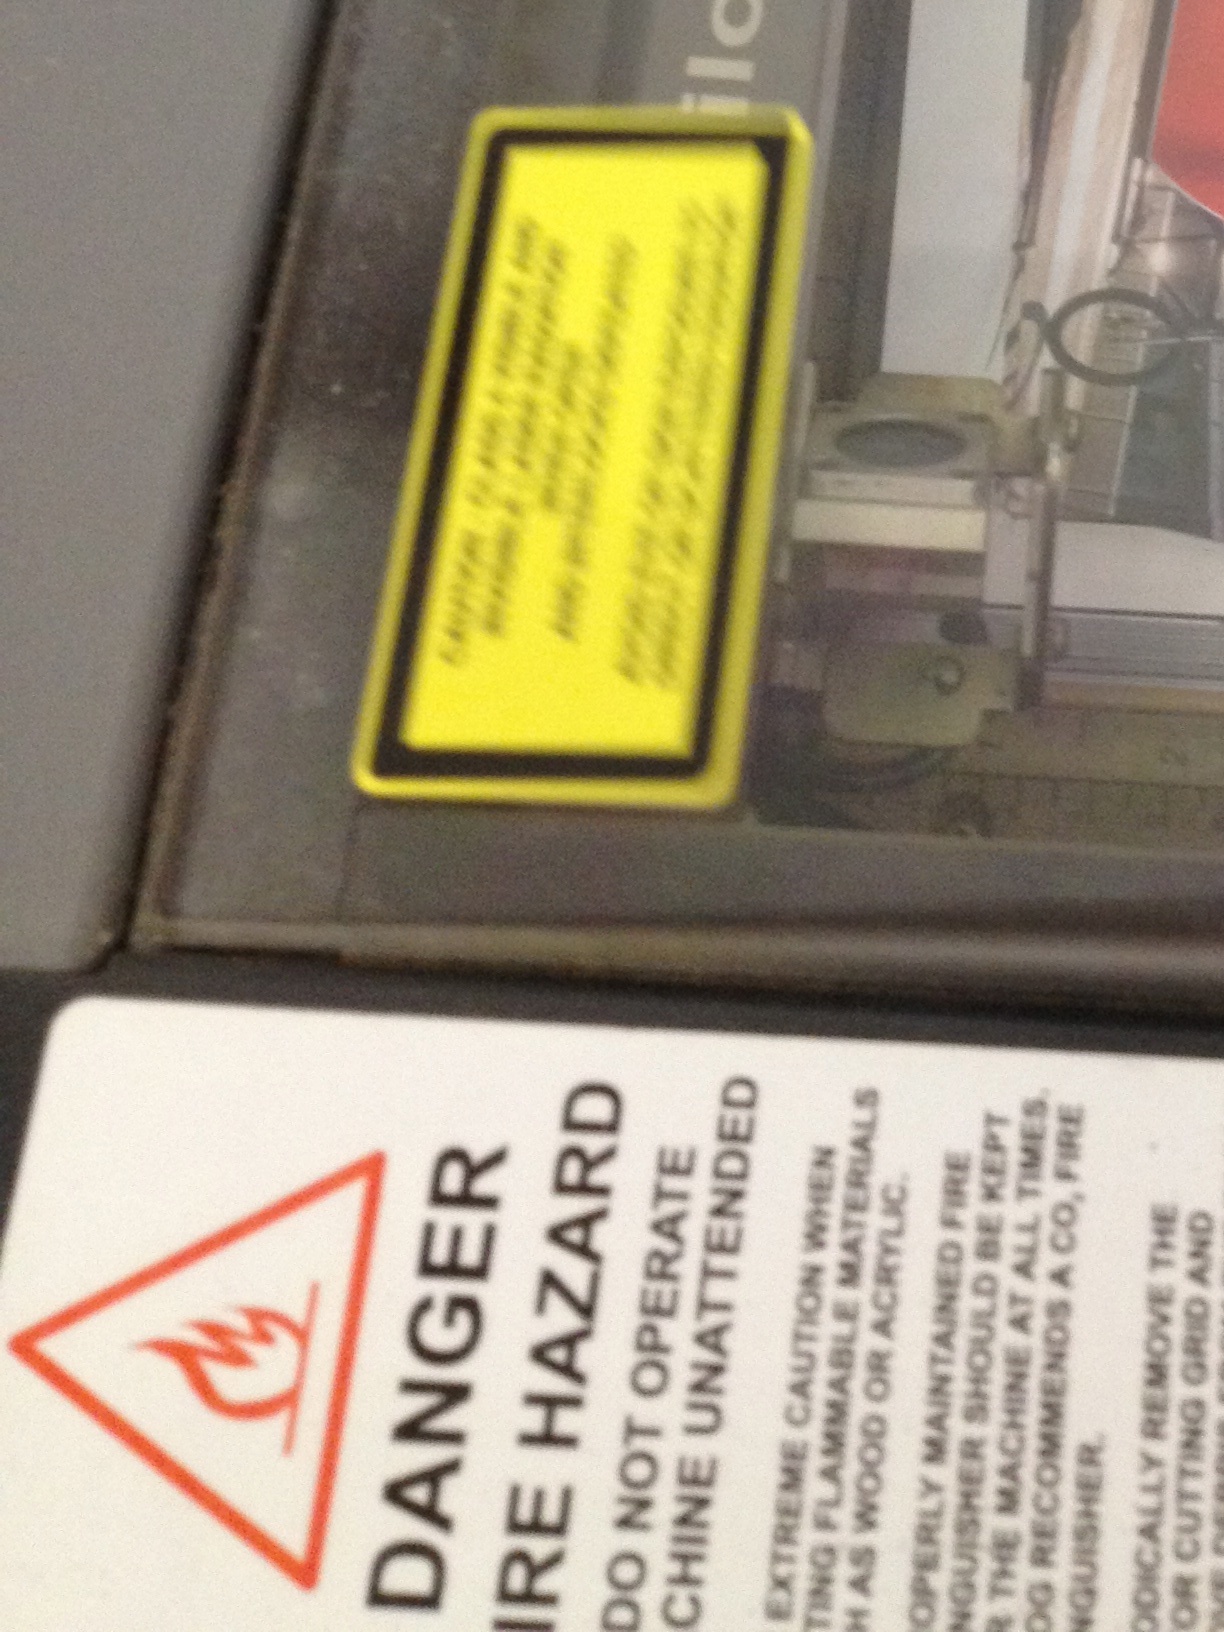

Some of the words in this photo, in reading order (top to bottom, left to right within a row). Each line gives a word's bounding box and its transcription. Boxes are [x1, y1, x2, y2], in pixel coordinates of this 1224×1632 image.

[803, 1145, 837, 1253] WHEN
[836, 1088, 879, 1289] MATERIALS
[939, 1152, 971, 1231] FIRE
[980, 1112, 1009, 1204] KEPT
[1053, 1105, 1084, 1183] FIRE
[518, 1081, 623, 1450] HAZARD
[629, 1147, 696, 1399] OPERATE
[683, 1075, 759, 1437] UNATTENDED
[974, 1214, 1003, 1263] BE
[1011, 1216, 1041, 1281] ALL
[1048, 1264, 1073, 1289] A
[1148, 1204, 1179, 1271] THE
[1186, 1210, 1215, 1288] AND
[784, 1262, 825, 1429] CAUTION
[921, 1239, 964, 1466] MAINTAINED
[962, 1272, 999, 1425] SHOULD
[1007, 1292, 1033, 1335] AT
[1140, 1285, 1174, 1442] REMOVE
[1181, 1295, 1211, 1387] GRID
[366, 1146, 507, 1612] DANGER
[813, 1301, 859, 1532] FLAMMABLE
[863, 1349, 893, 1404] OR
[994, 1347, 1032, 1517] MACHINE
[1029, 1298, 1072, 1569] RECOMMENDS
[613, 1417, 662, 1533] NOT
[764, 1440, 808, 1622] EXTREME
[853, 1413, 888, 1534] WOOD
[1173, 1396, 1207, 1563] CUTTING
[492, 1485, 573, 1632] IRE
[600, 1550, 647, 1632] DO
[661, 1457, 717, 1632] CHINE
[803, 1543, 838, 1632] TING
[847, 1544, 877, 1598] AS
[988, 1530, 1022, 1600] THE
